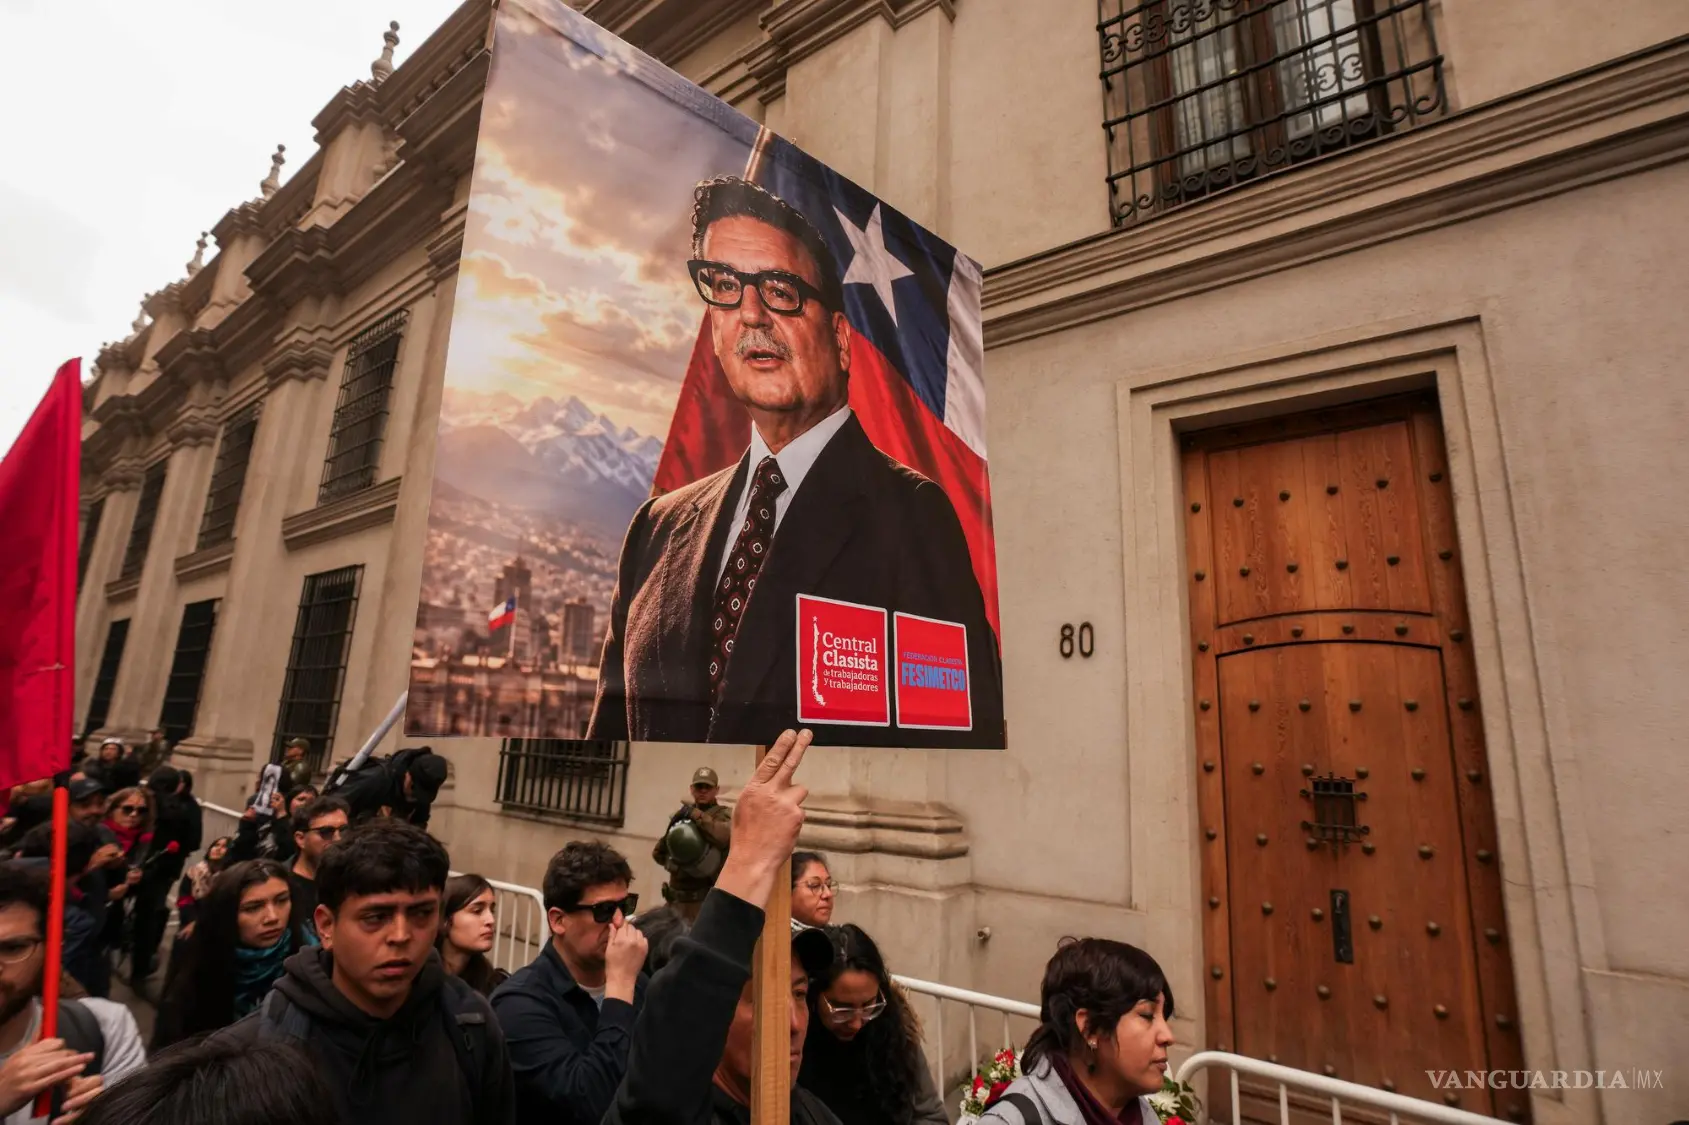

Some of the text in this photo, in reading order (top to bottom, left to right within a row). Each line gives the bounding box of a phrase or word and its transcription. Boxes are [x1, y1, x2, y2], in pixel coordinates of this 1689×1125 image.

[822, 632, 877, 654] Central
[1060, 621, 1094, 659] 80
[822, 649, 878, 671] Clasista
[823, 669, 878, 682] de trabajadoras
[824, 677, 878, 692] y trabajadores
[901, 661, 966, 692] FESIMETCO
